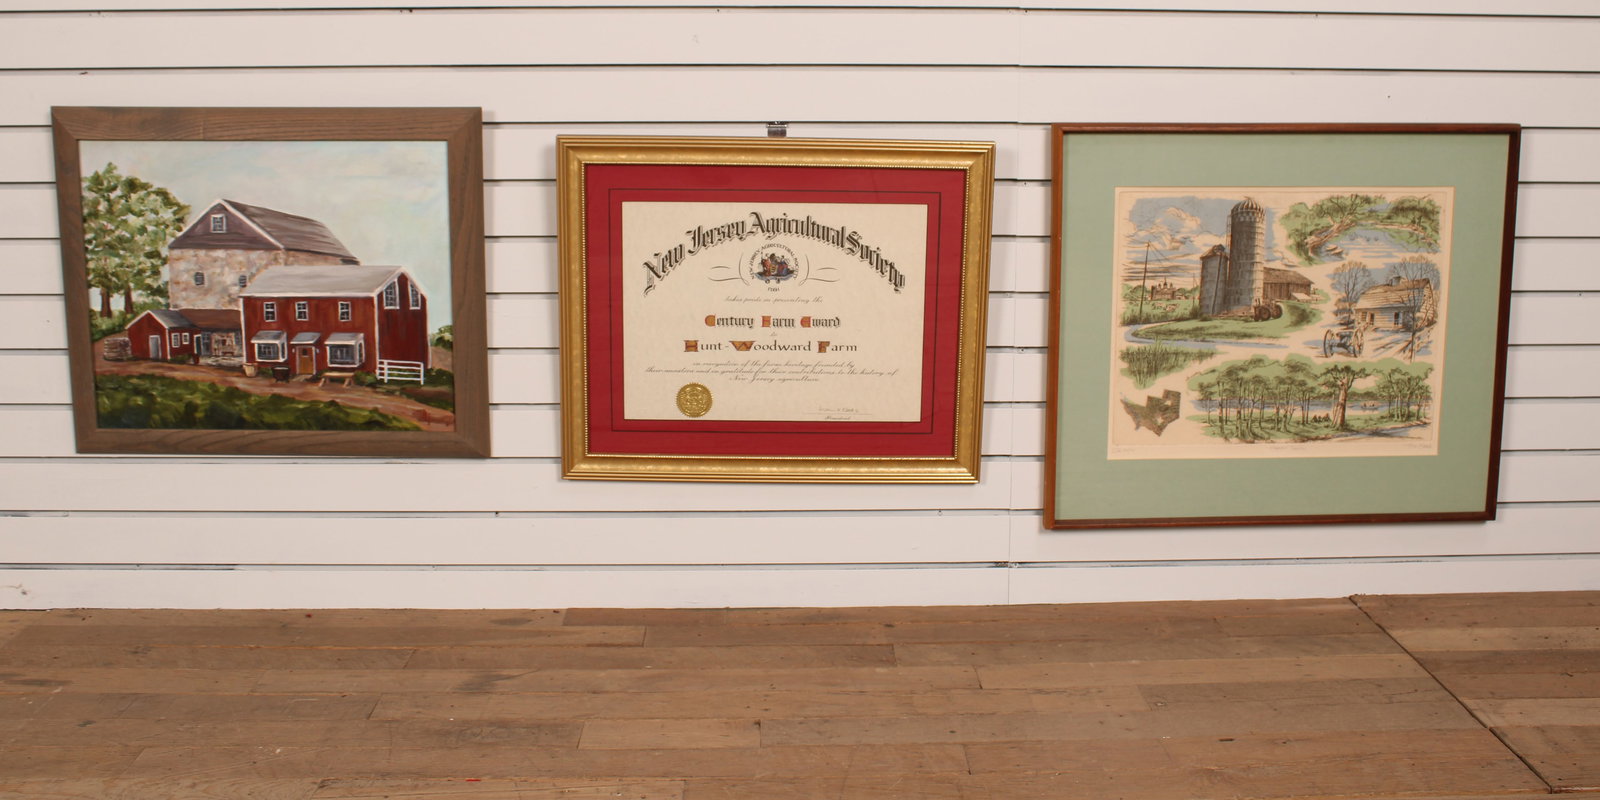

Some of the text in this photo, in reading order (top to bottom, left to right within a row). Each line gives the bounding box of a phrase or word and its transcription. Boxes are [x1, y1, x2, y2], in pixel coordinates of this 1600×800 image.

[642, 211, 905, 296] New Jersey Agricultural Society
[705, 314, 841, 328] Century Farm Award
[817, 341, 857, 353] Farm
